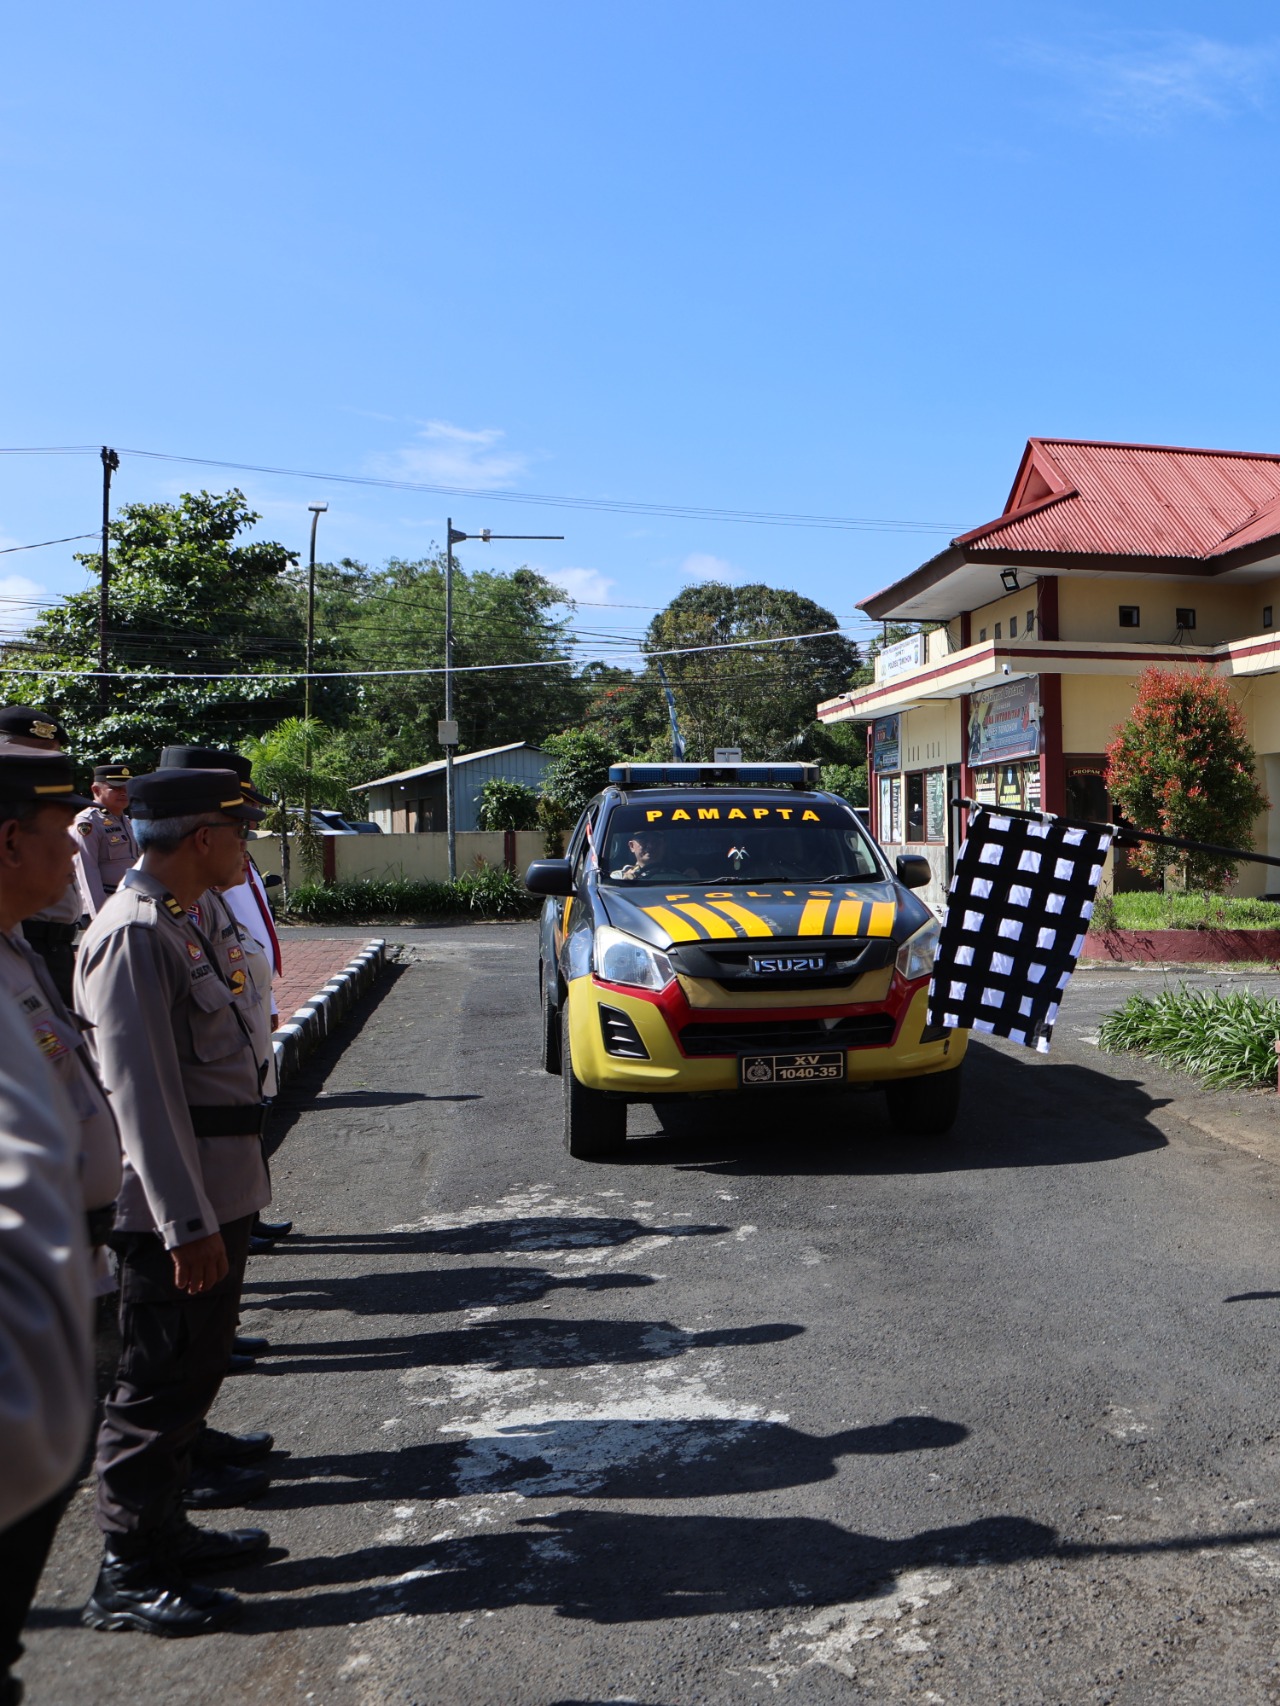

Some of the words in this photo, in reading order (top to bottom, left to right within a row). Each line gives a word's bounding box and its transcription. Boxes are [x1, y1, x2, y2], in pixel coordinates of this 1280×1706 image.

[646, 808, 821, 822] PAMAPTA
[665, 890, 858, 902] POLISI
[754, 957, 824, 973] ISUZU
[780, 1066, 838, 1079] 1040-35
